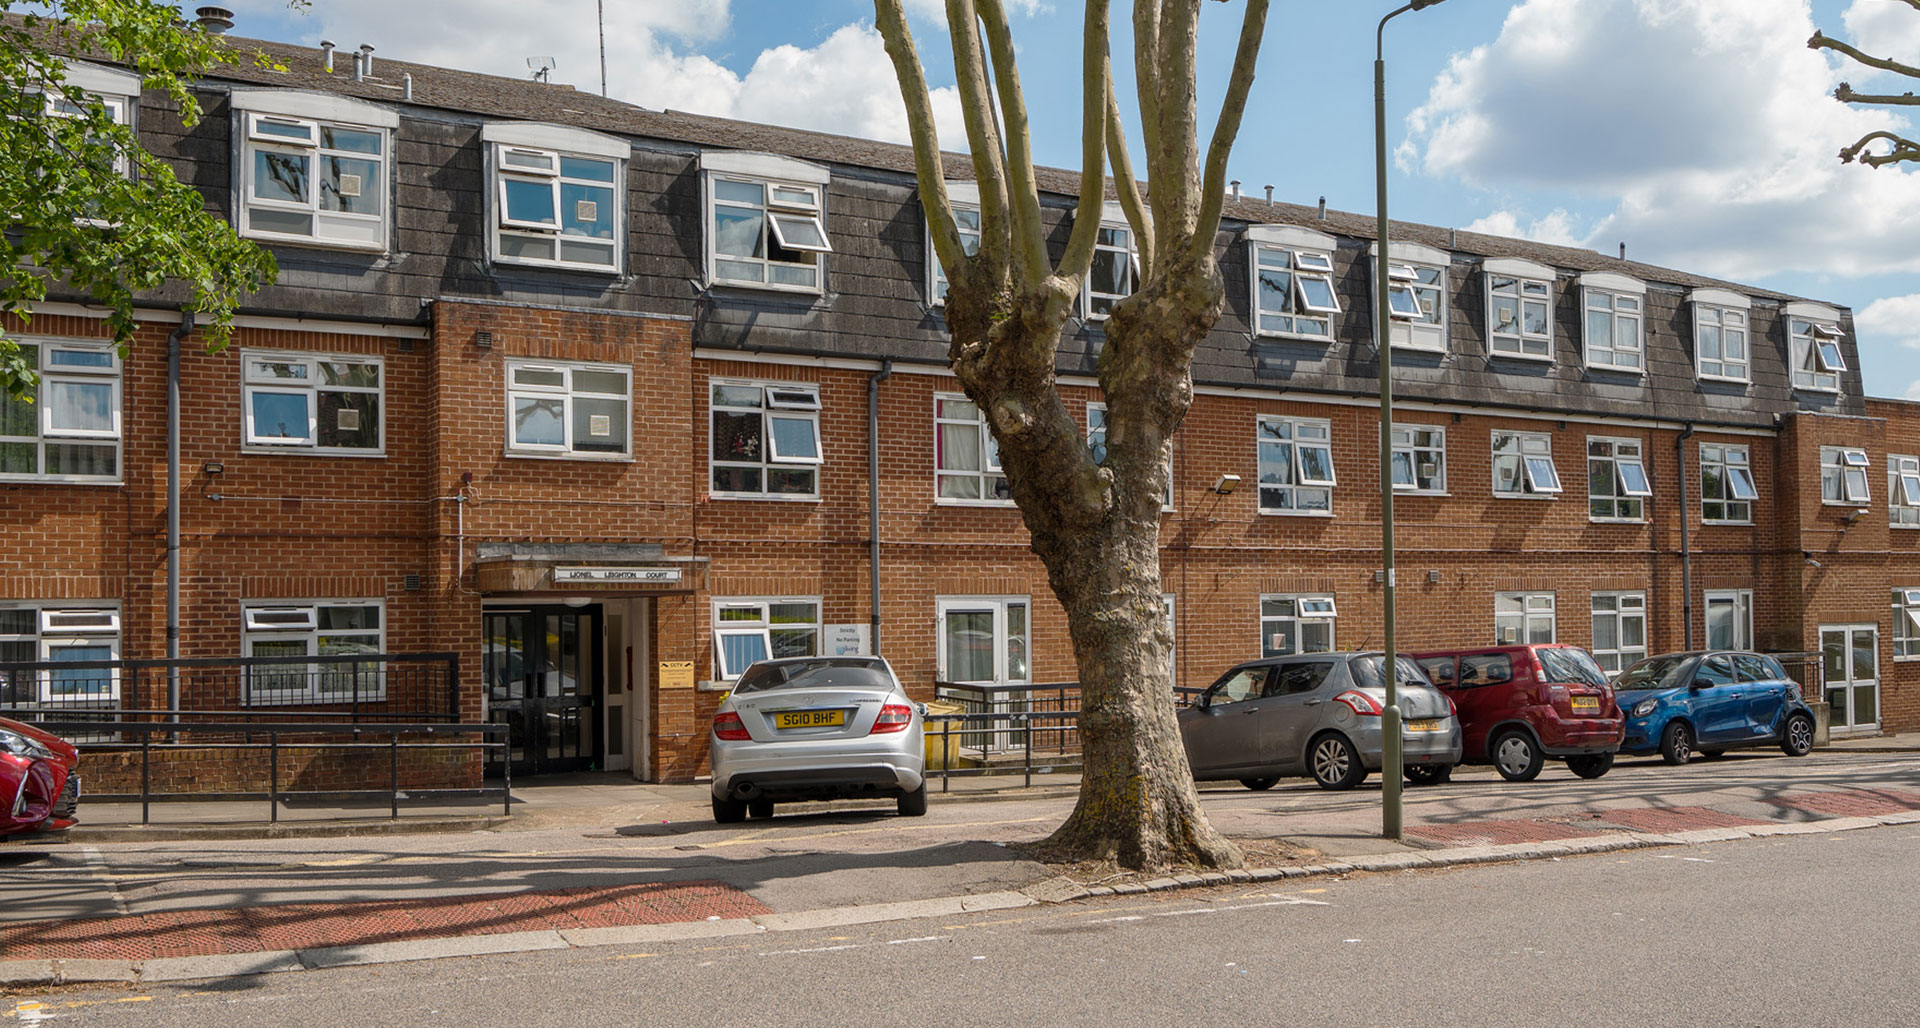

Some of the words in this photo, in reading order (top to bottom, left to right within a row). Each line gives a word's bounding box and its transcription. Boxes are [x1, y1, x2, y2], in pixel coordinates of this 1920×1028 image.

[569, 571, 594, 579] LIONEL
[604, 571, 637, 579] LEIGHTON
[783, 713, 811, 726] SG10
[813, 711, 837, 724] BHF
